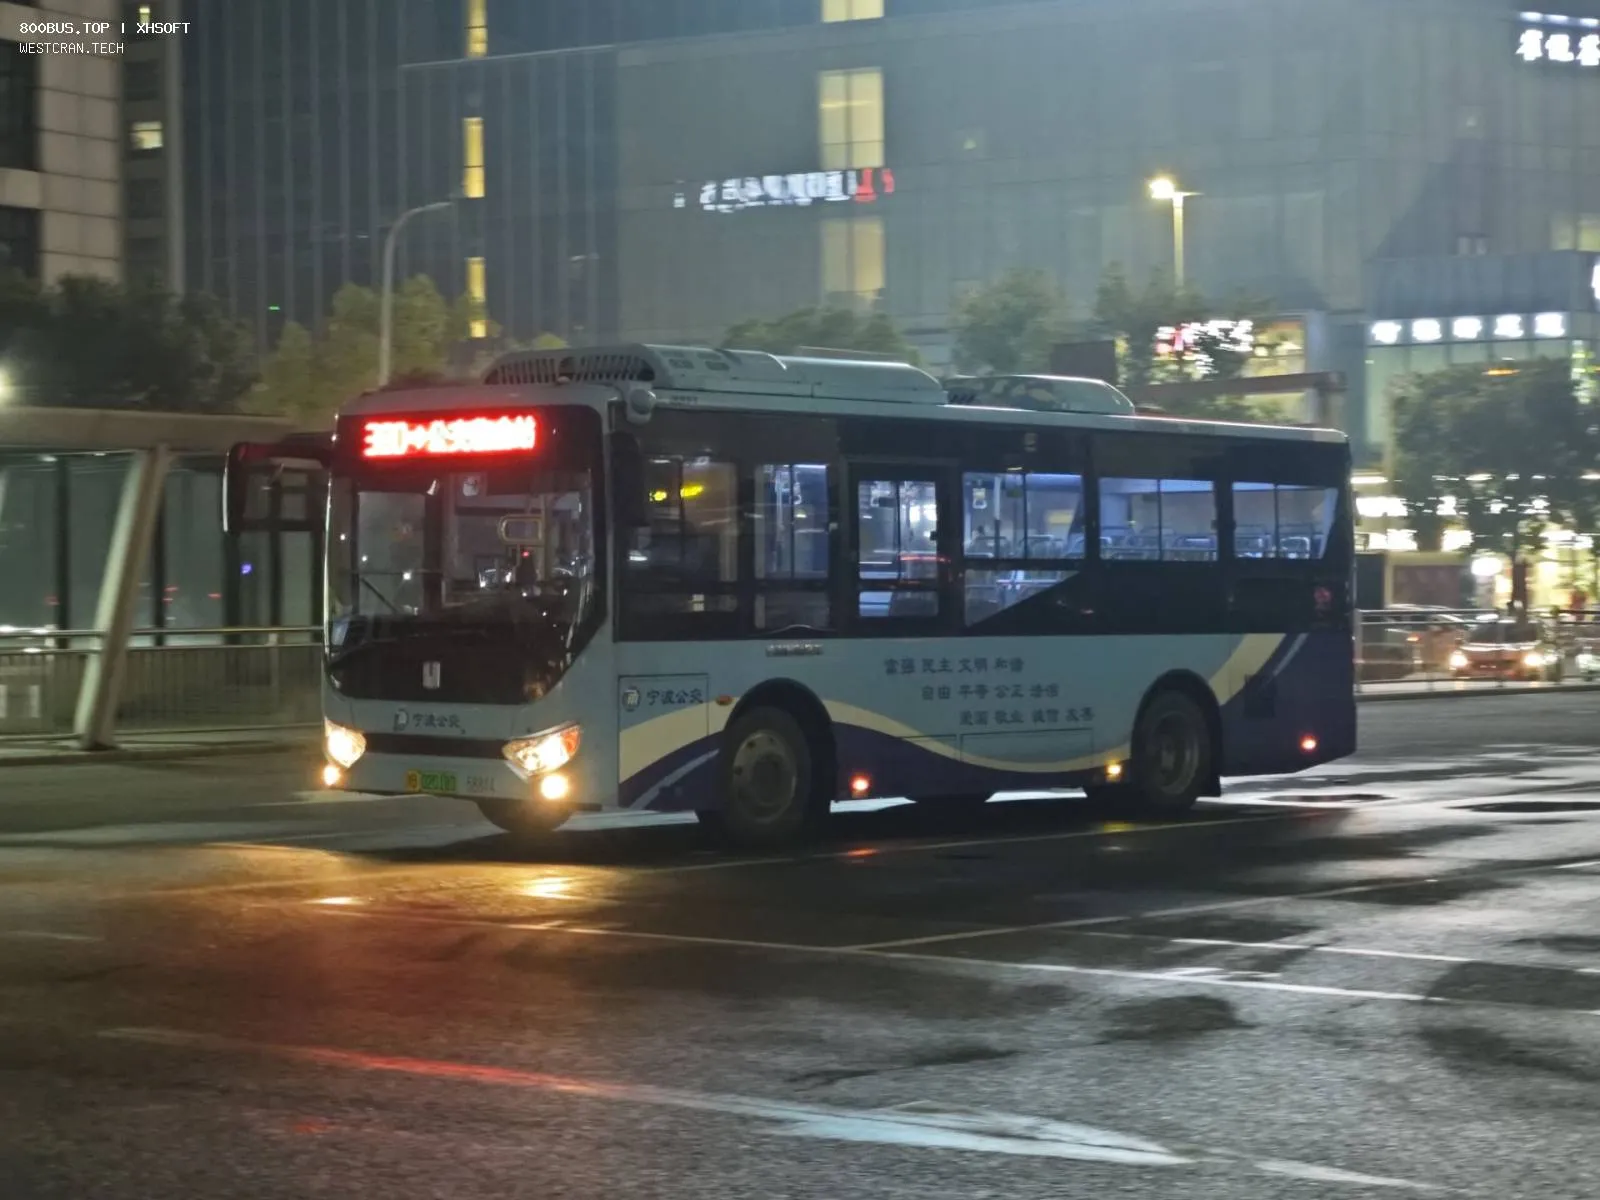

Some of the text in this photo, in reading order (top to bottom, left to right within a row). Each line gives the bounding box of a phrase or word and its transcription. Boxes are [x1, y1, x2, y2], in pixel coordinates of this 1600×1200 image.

[921, 658, 953, 674] 民主
[958, 657, 988, 673] 文明
[646, 687, 704, 706] 宁波公交
[921, 685, 951, 701] 自由
[994, 684, 1024, 699] 公正
